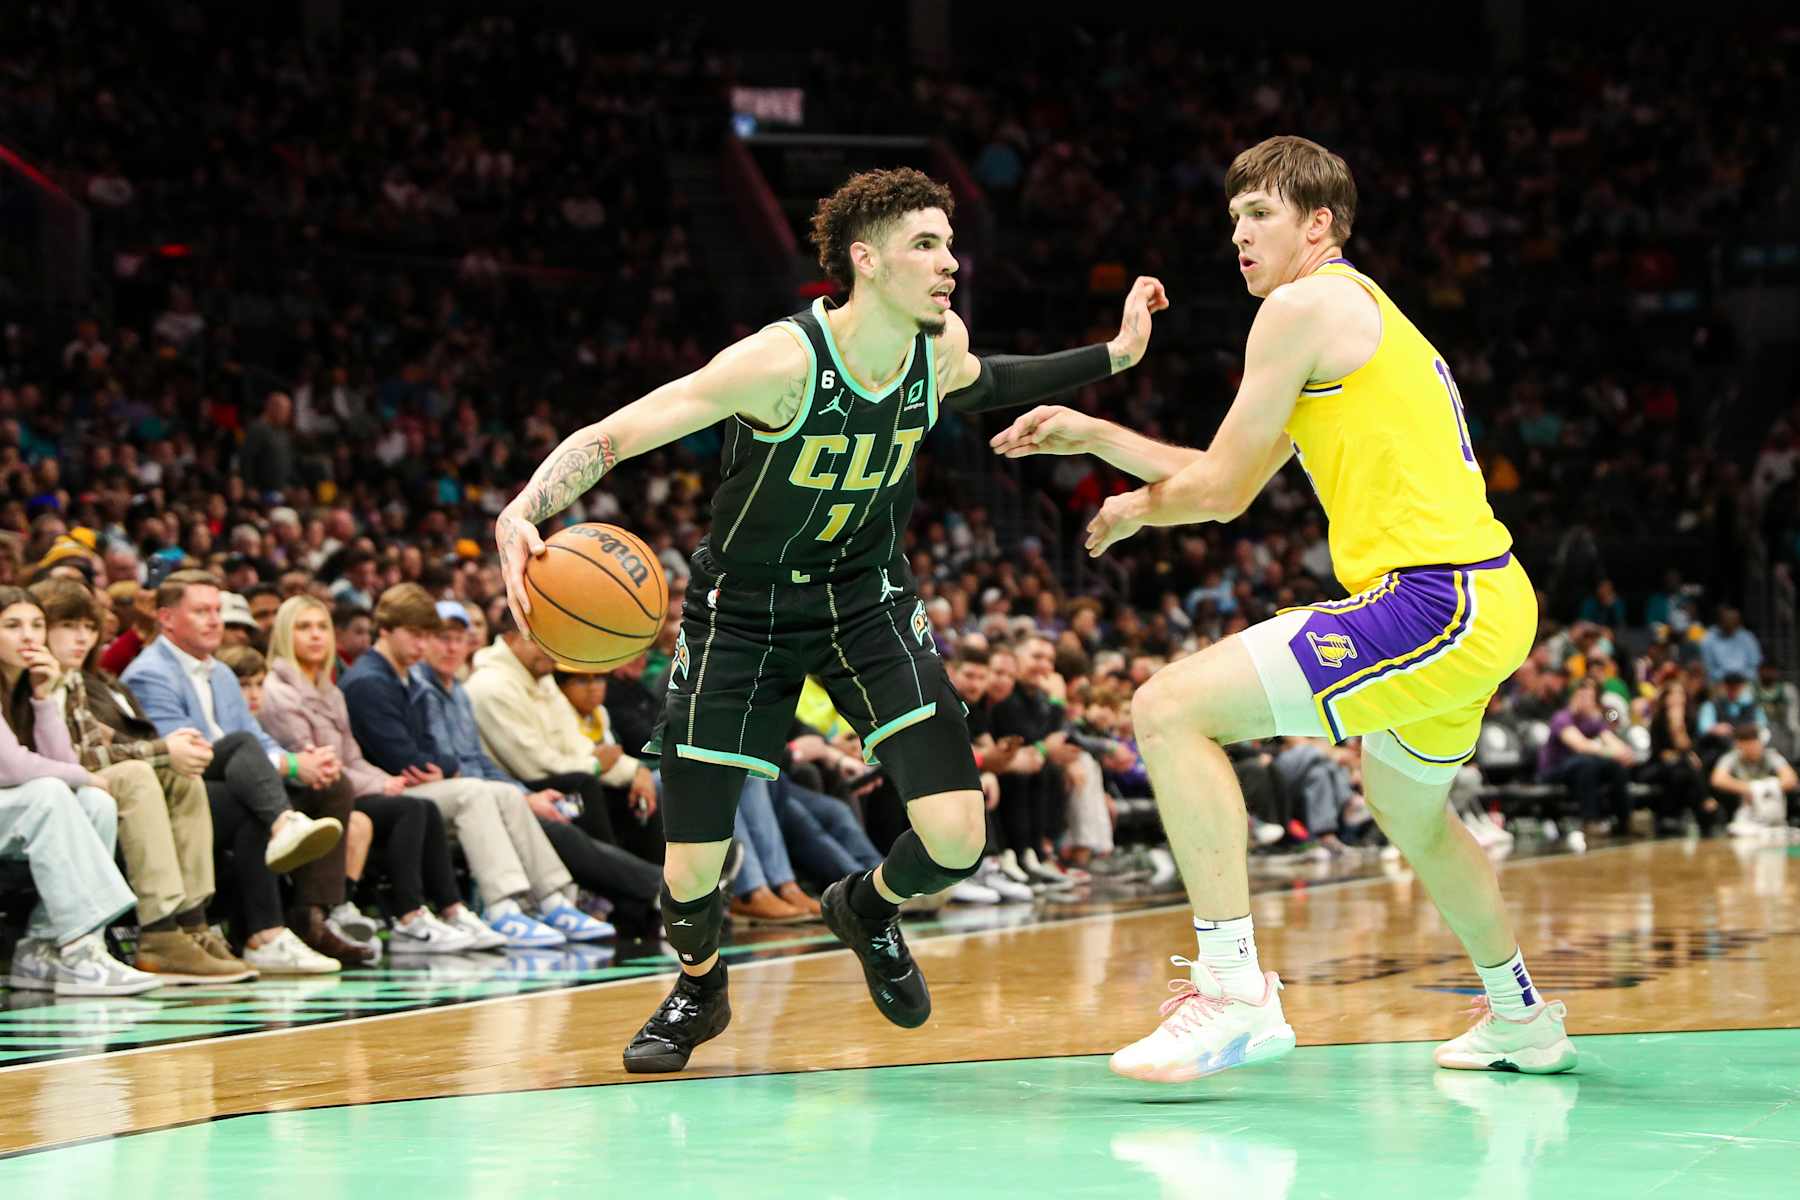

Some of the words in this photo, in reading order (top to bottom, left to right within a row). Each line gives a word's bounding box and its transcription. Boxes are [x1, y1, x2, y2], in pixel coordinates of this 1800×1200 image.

[821, 369, 836, 389] 6
[788, 426, 925, 491] CLT
[815, 503, 856, 542] 1
[568, 526, 649, 589] Wilson
